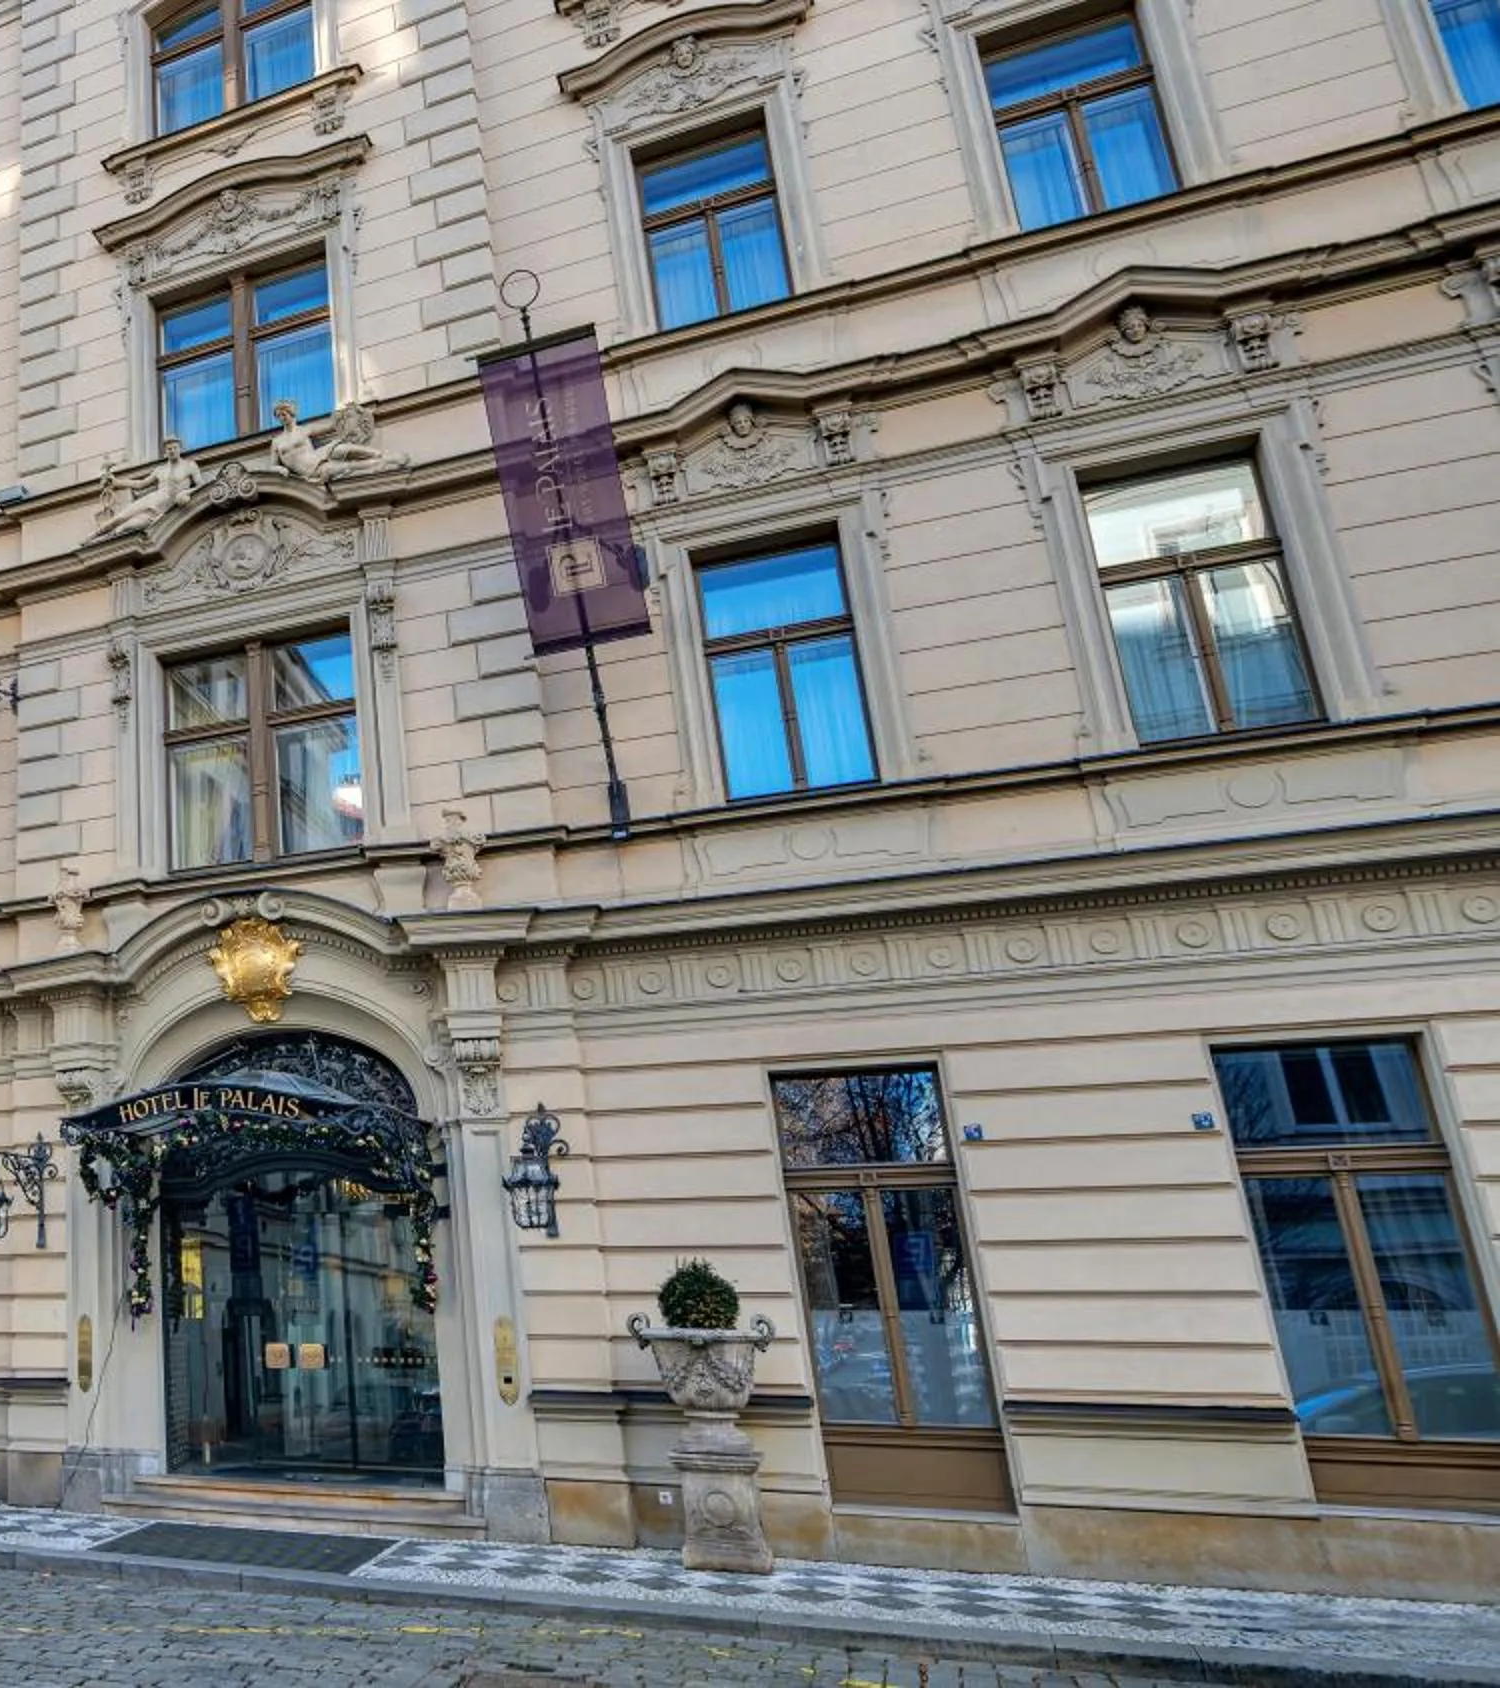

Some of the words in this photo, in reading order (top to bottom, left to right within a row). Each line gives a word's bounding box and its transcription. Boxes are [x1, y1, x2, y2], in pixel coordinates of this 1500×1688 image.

[525, 396, 565, 500] PALAIS
[119, 1091, 187, 1122] HOTEL
[220, 1087, 300, 1117] PALAIS
